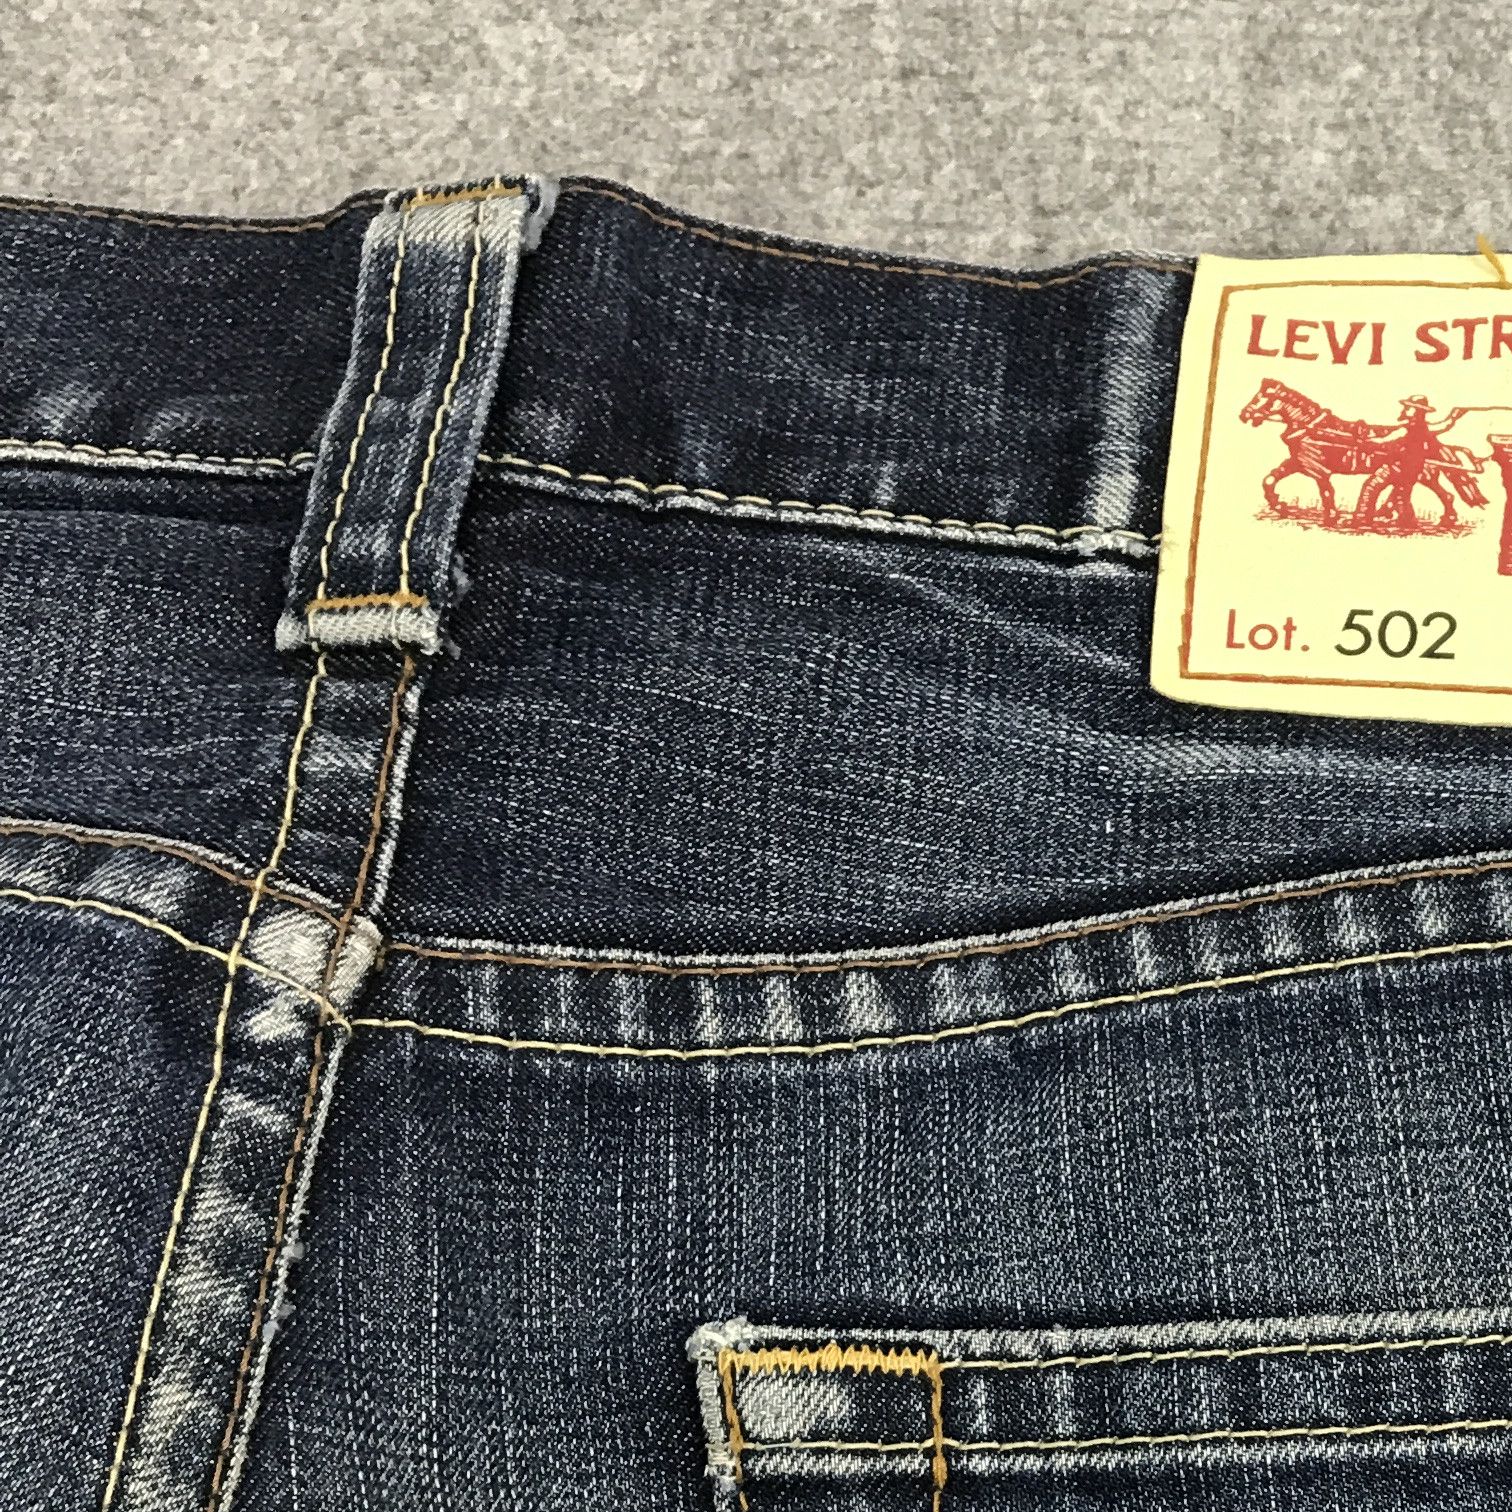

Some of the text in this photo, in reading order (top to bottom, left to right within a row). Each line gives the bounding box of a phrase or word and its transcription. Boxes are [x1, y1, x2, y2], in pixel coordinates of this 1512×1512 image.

[1247, 314, 1386, 365] LEVI
[1225, 609, 1309, 653] Lot.
[1334, 609, 1457, 661] 502
